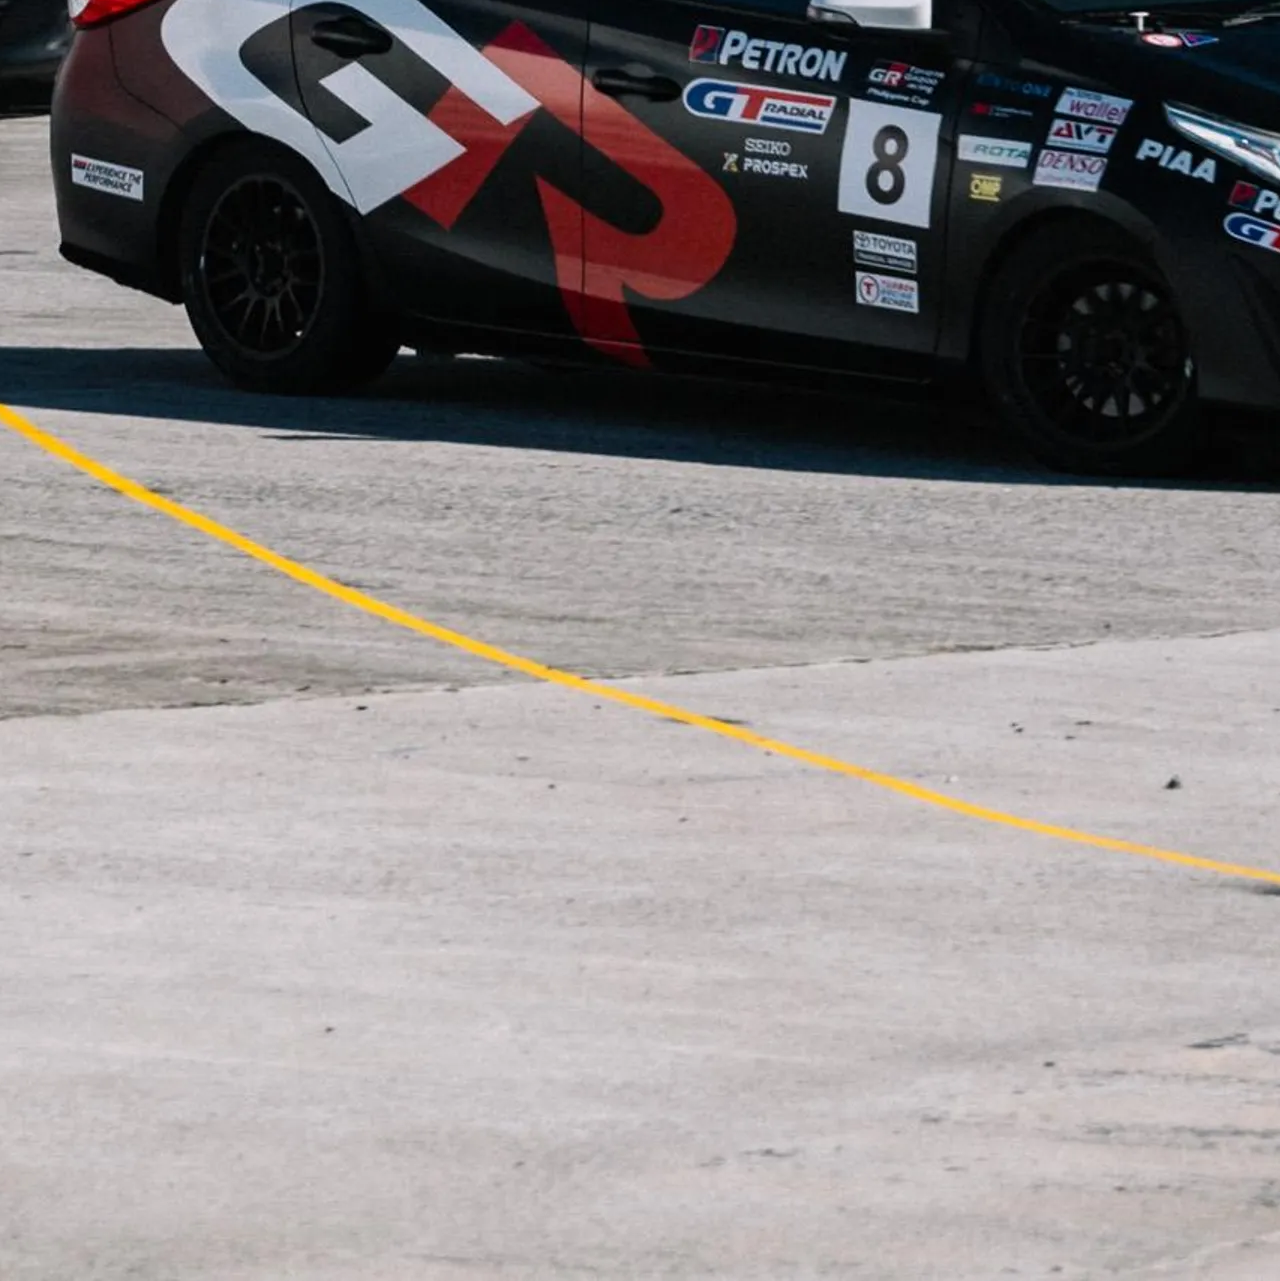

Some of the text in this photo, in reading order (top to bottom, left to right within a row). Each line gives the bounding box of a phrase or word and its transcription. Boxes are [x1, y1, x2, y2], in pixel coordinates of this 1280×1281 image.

[719, 30, 848, 82] PETRON
[868, 67, 902, 87] GR
[686, 81, 827, 121] GT RADIAL
[1051, 120, 1117, 144] AVT
[744, 137, 792, 156] SEIKO
[972, 143, 1029, 160] ROTA
[743, 157, 809, 180] PROSPEX
[866, 124, 909, 205] 8
[1039, 151, 1107, 175] DENSO
[1136, 138, 1217, 184] PIAA
[870, 236, 915, 257] TOYOTA
